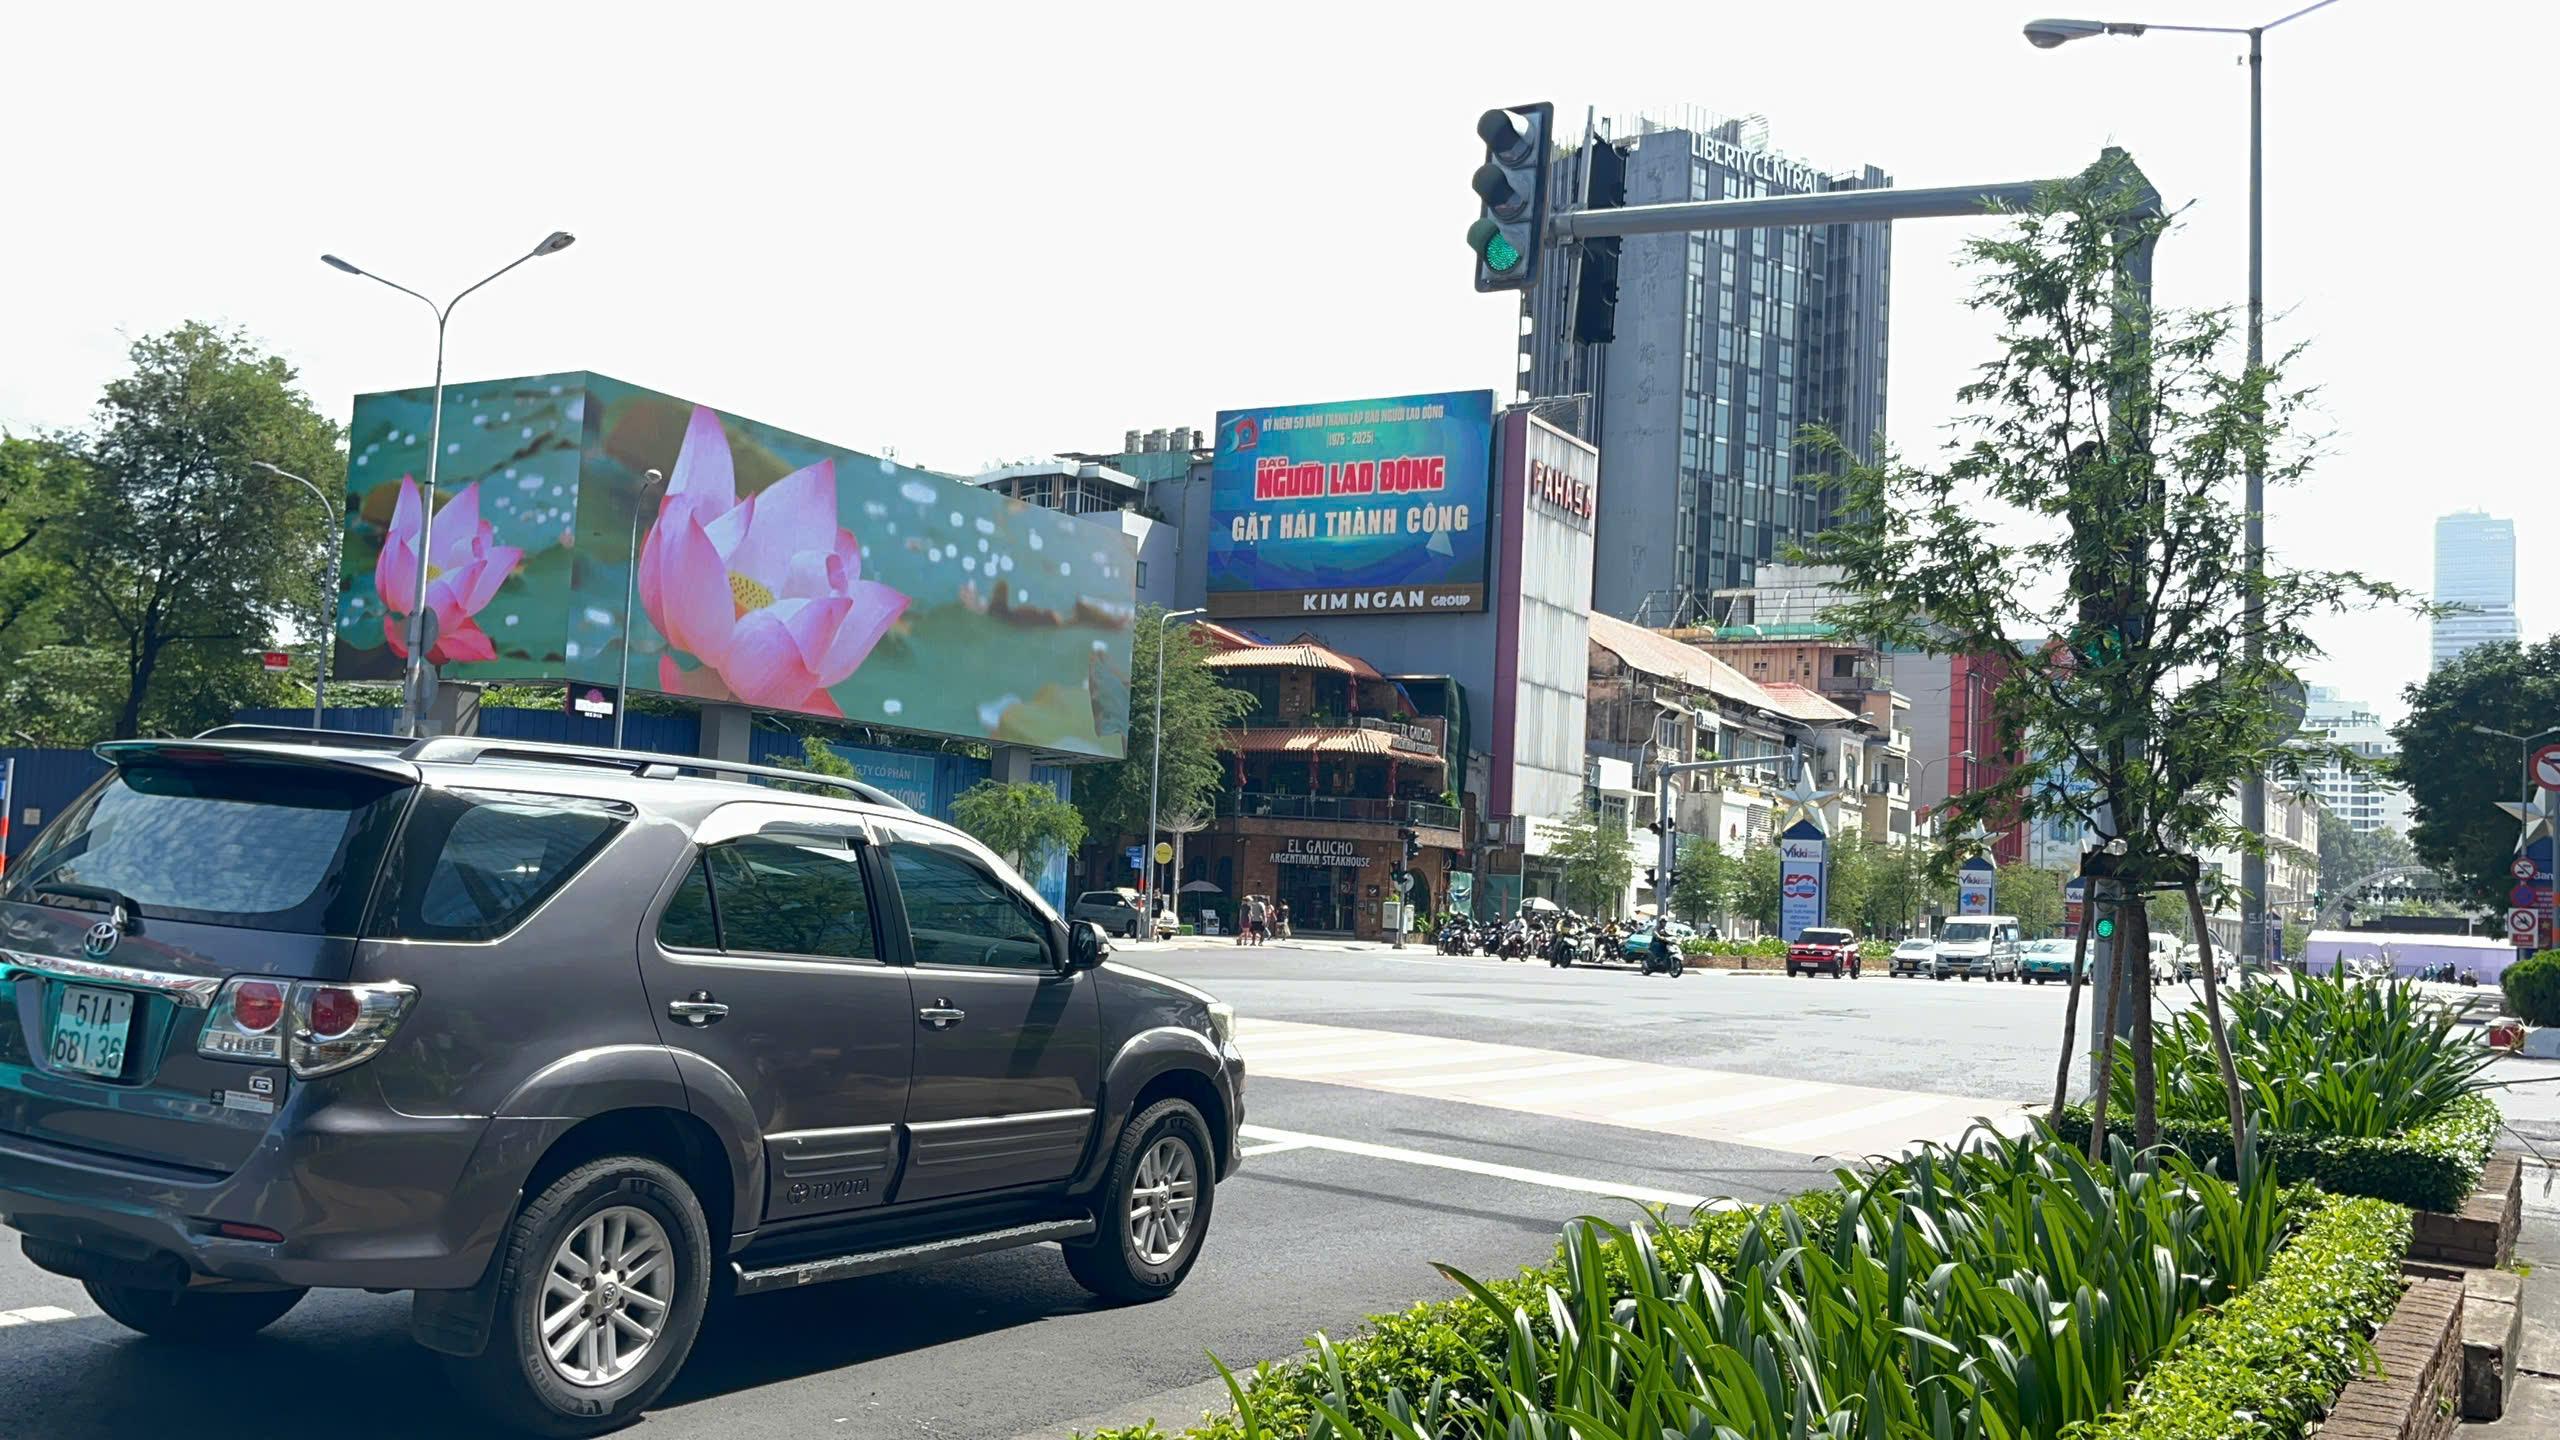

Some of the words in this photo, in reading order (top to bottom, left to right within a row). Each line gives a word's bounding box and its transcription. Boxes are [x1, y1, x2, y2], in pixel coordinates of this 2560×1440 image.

[1691, 132, 1752, 173] LIBERTY
[1294, 416, 1304, 430] 50
[1256, 463, 1324, 498] NGƯỜI
[1330, 462, 1374, 494] LAO
[1379, 456, 1445, 494] ĐỘNG
[1531, 459, 1593, 520] FAHASA
[1232, 511, 1272, 546] GẶT
[1280, 510, 1316, 539] HÁI
[1325, 506, 1397, 537] THÀNH
[1407, 502, 1469, 534] CÔNG
[1303, 593, 1347, 611] KIM
[1354, 590, 1424, 610] NGAN
[1431, 595, 1471, 607] GROUP
[1269, 852, 1320, 865] ARGENTINIAN
[1322, 855, 1371, 868] STEAKHOUSE
[1288, 839, 1302, 853] EL
[1306, 840, 1353, 855] GAUCHO
[1783, 843, 1808, 858] Vikki
[75, 993, 113, 1031] 51A
[55, 1028, 123, 1071] 681.36
[813, 1178, 869, 1199] TOYOTA
